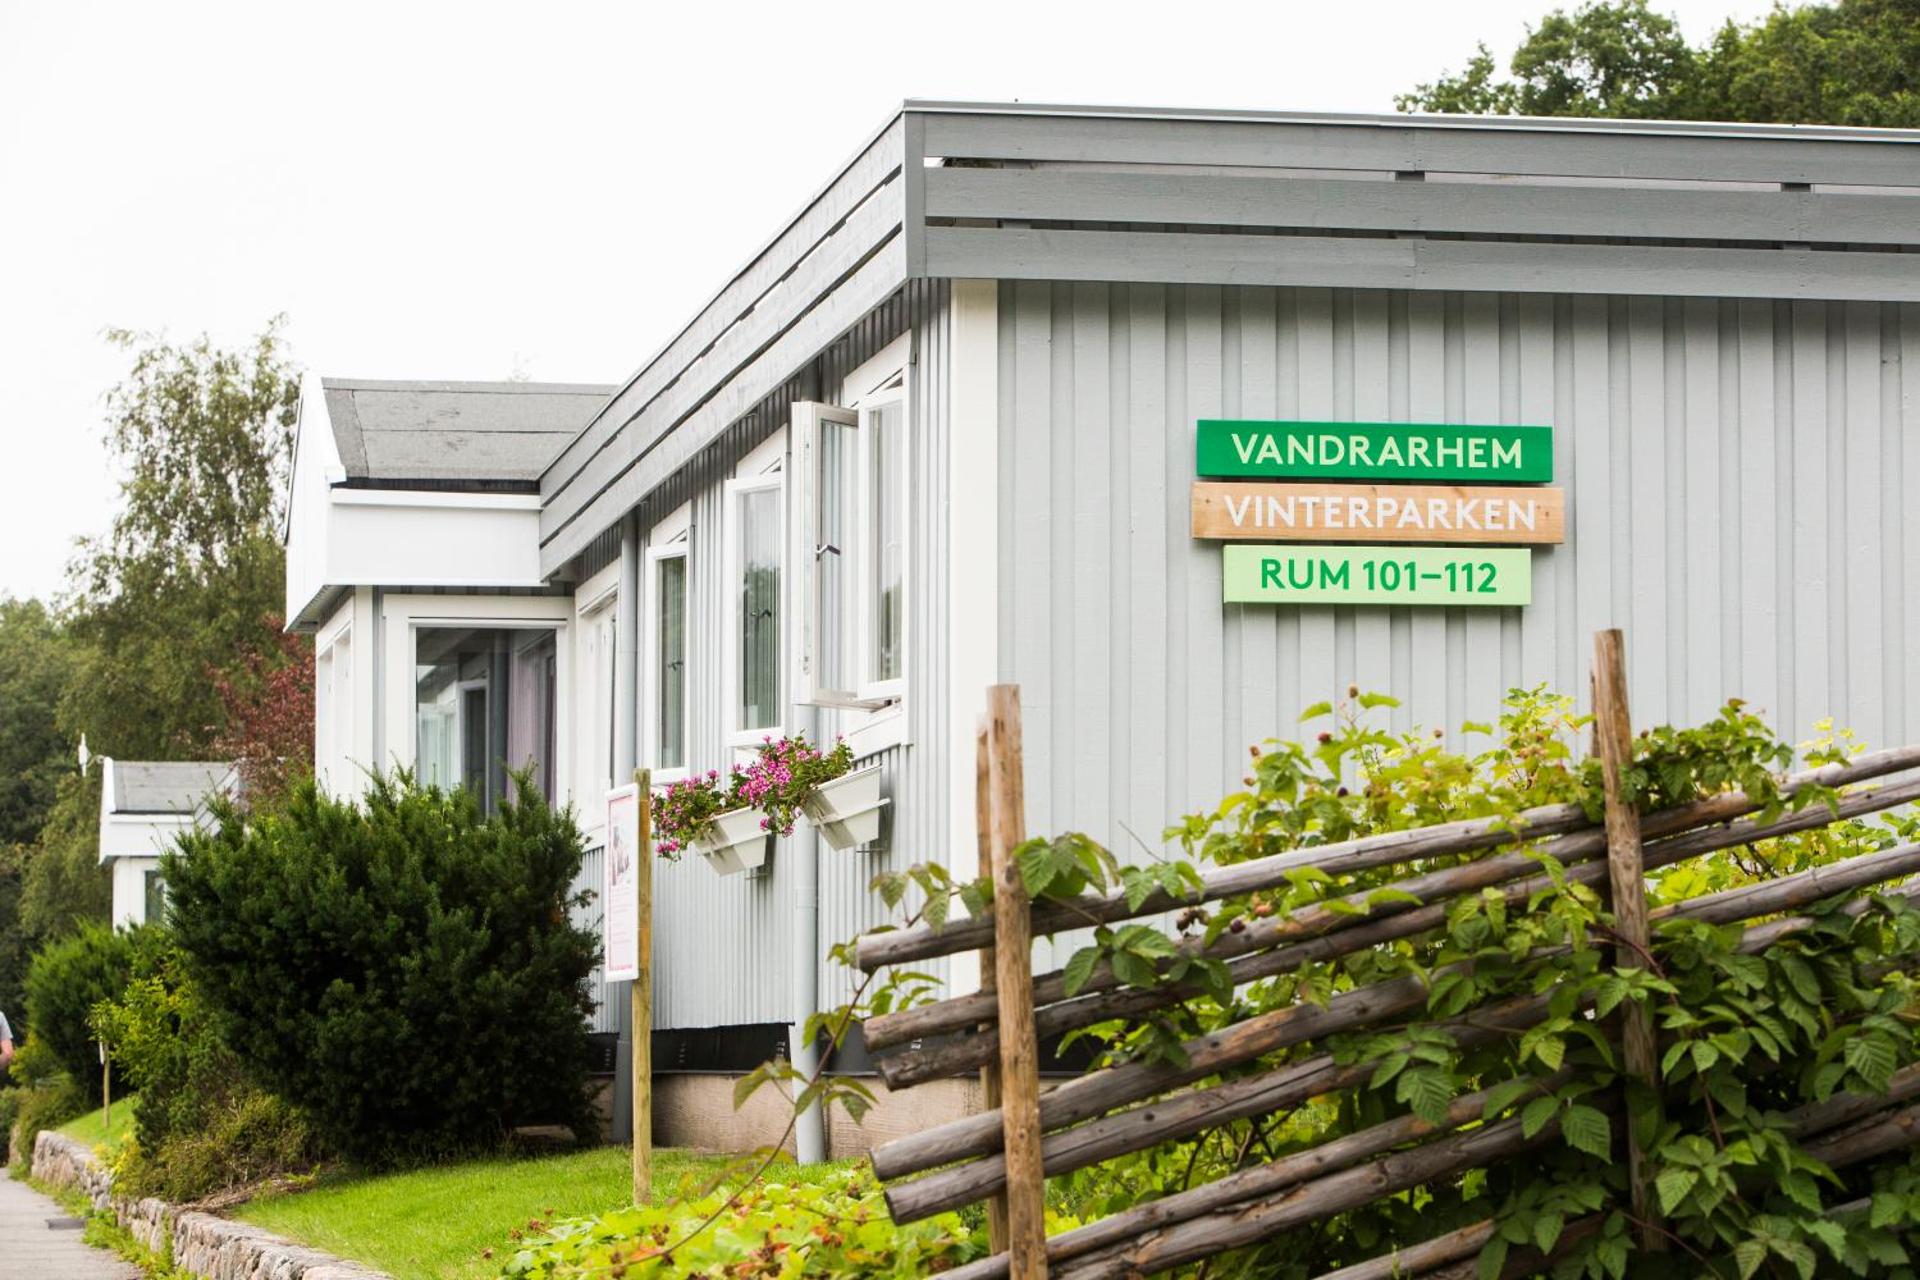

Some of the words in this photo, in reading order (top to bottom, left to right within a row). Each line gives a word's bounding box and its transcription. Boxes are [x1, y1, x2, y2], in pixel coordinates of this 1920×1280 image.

[1231, 433, 1522, 468] VANDRARHEM
[1224, 495, 1535, 530] VINTERPARKEN
[1261, 558, 1350, 590] RUM
